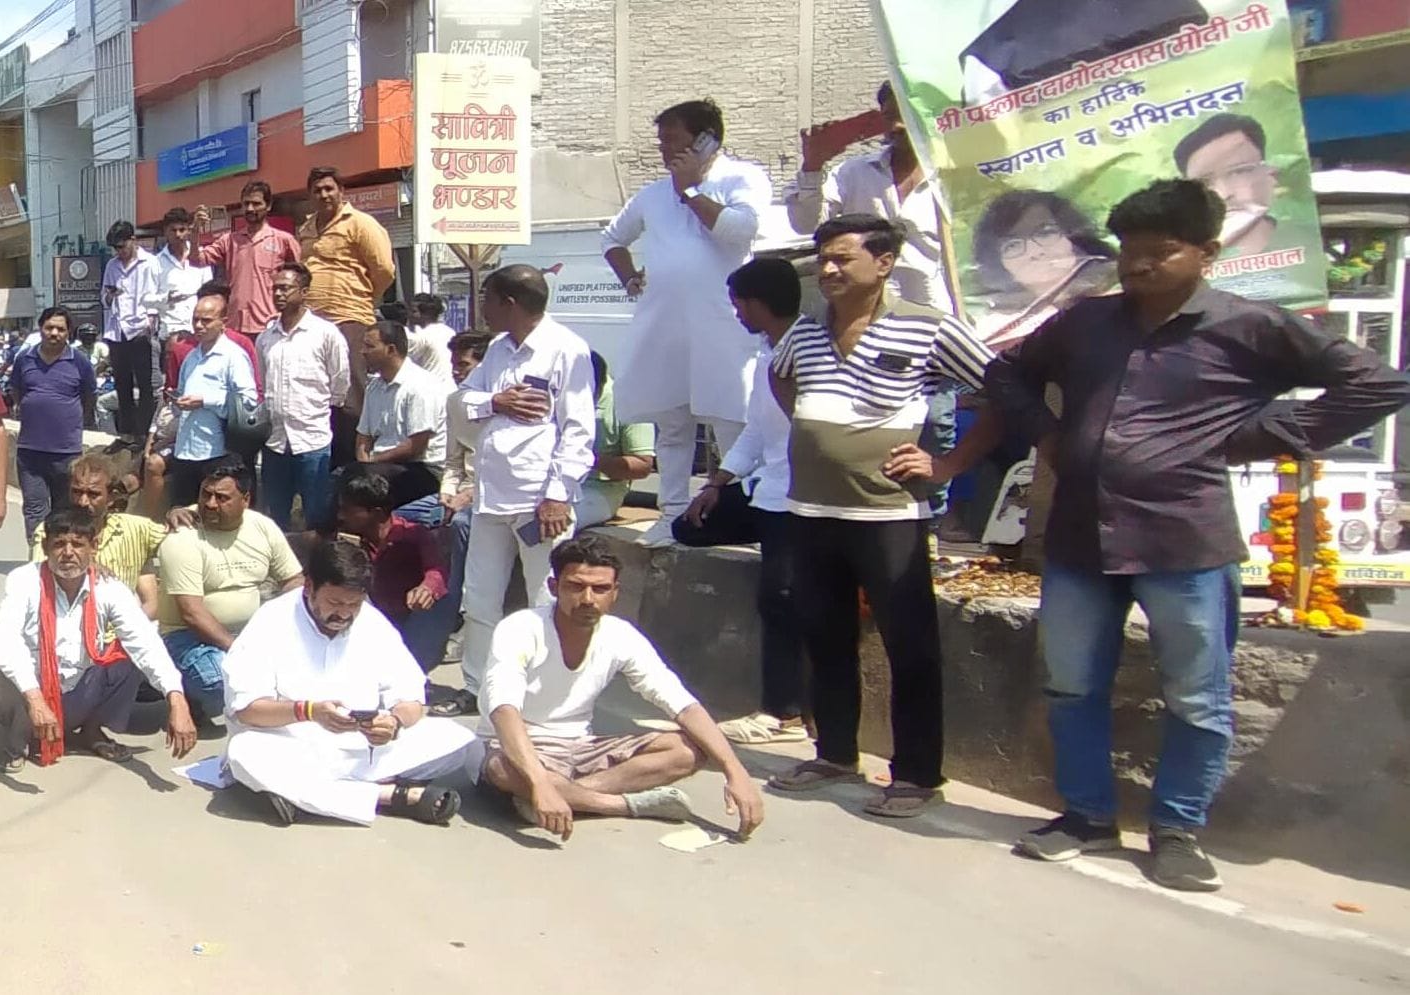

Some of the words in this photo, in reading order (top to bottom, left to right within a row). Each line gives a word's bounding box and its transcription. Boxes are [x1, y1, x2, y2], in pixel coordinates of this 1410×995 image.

[936, 108, 961, 132] श्री
[1042, 42, 1167, 97] दामोदरदास
[1172, 17, 1229, 54] मोदी
[1231, 4, 1270, 31] जी
[1042, 106, 1071, 124] का
[1079, 81, 1146, 114] हार्दिक
[430, 102, 517, 140] सावित्री
[977, 139, 1065, 178] स्वागत
[1076, 128, 1097, 146] व
[1110, 81, 1246, 137] अभिनंदन
[430, 148, 518, 180] पूजन
[433, 184, 517, 210] भण्डार
[1216, 248, 1304, 275] जायसवाल
[556, 295, 589, 304] LIMITLESS
[558, 283, 585, 292] UNIFIED
